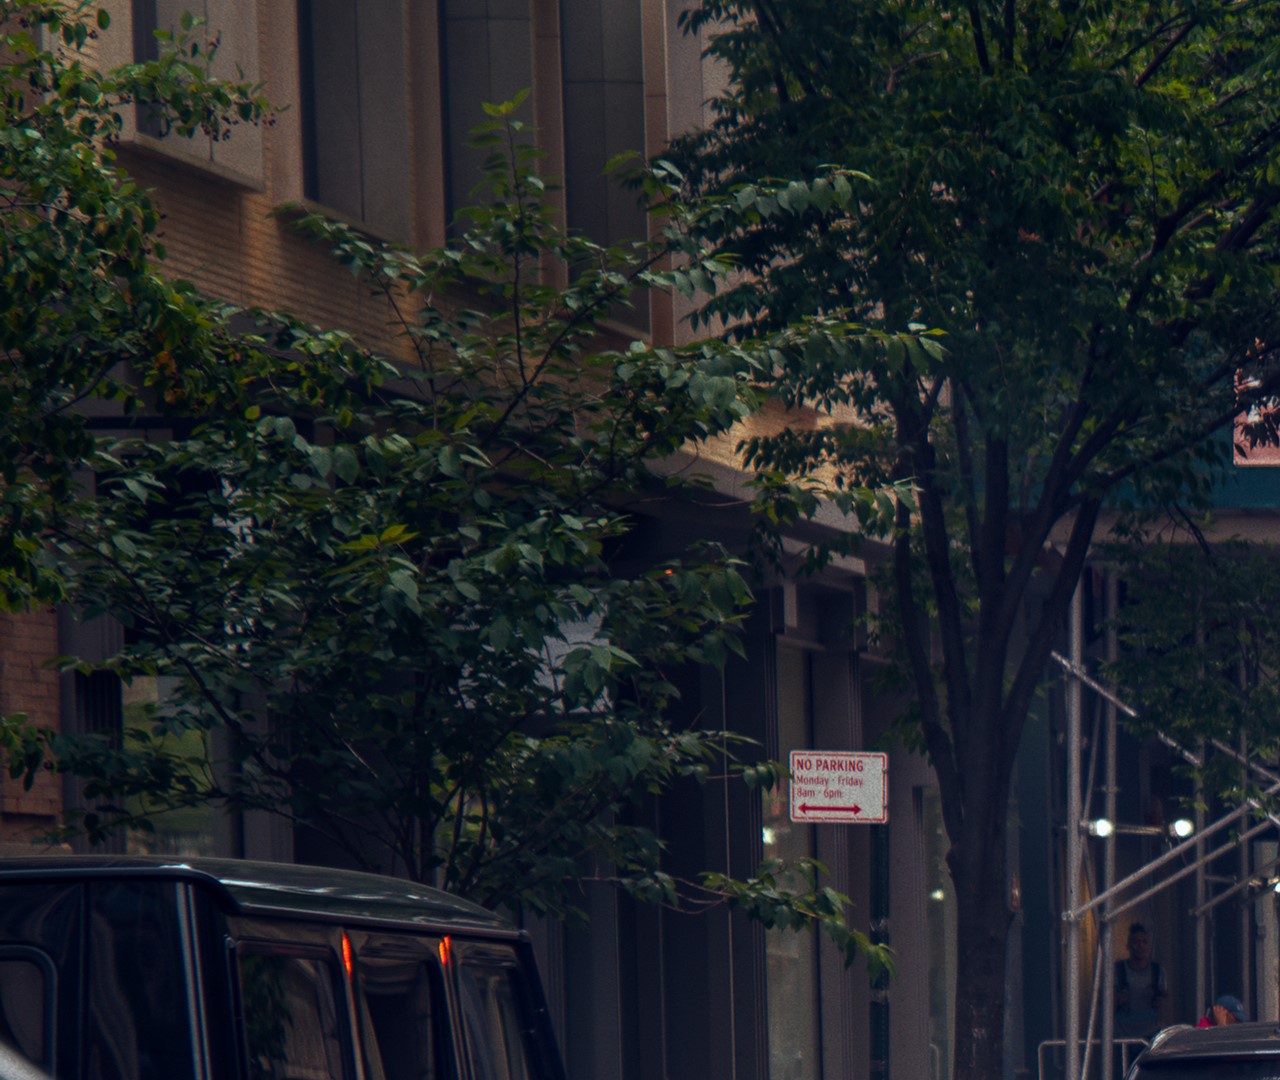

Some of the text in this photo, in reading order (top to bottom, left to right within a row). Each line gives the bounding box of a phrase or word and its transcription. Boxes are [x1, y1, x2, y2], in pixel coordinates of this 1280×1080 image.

[796, 759, 864, 772] NO PARKING
[796, 776, 863, 788] Monday Friday
[796, 788, 842, 800] 8am 6pm
